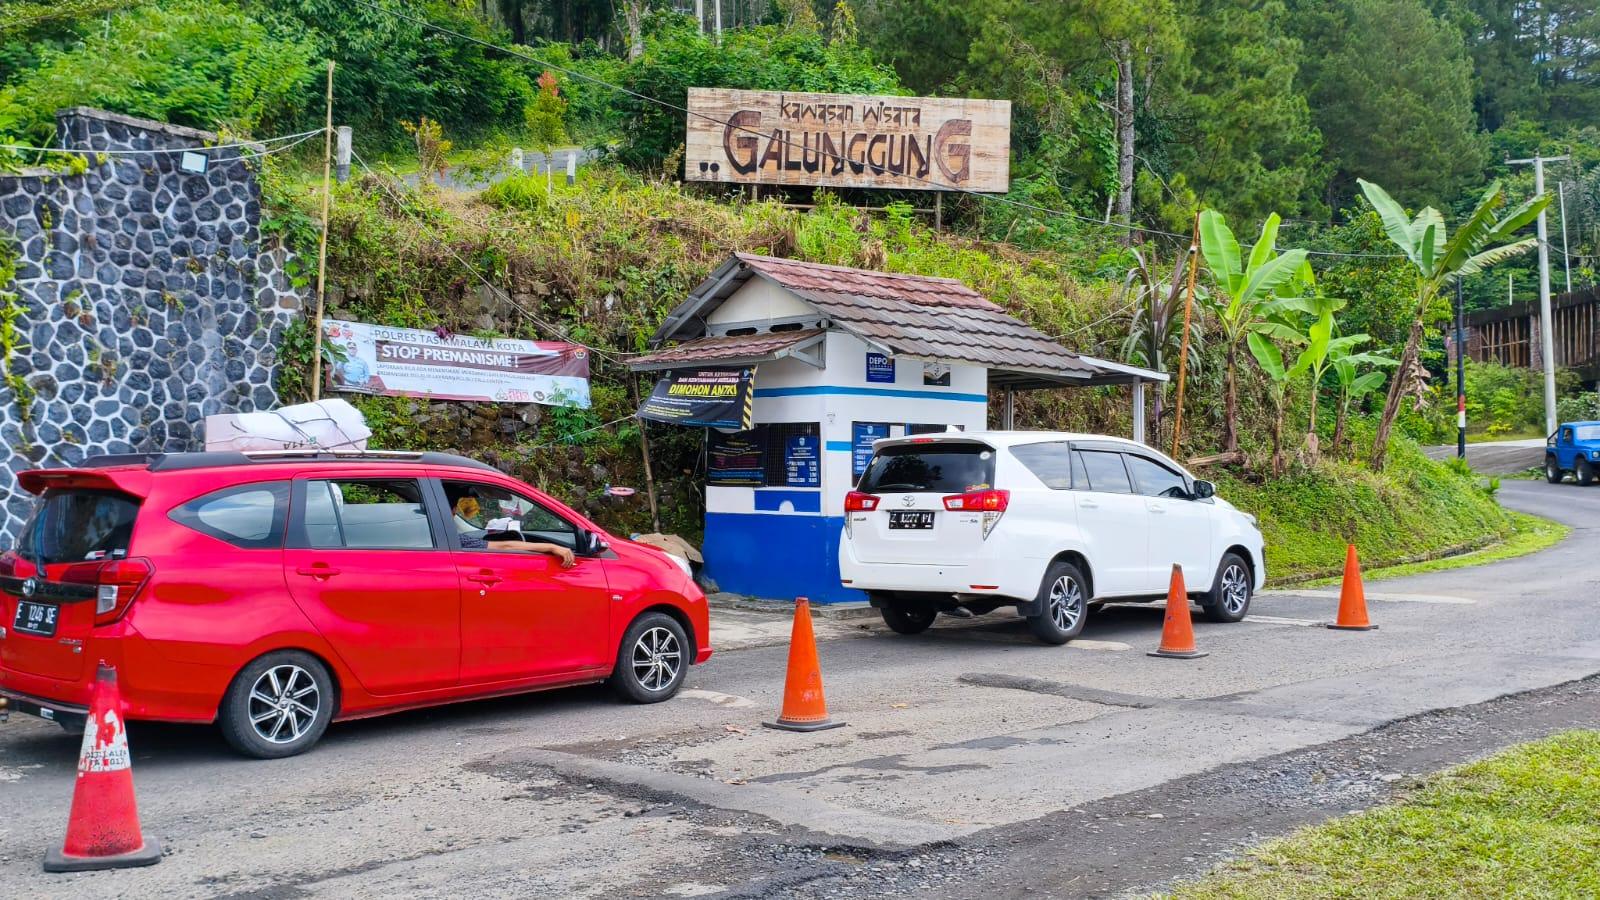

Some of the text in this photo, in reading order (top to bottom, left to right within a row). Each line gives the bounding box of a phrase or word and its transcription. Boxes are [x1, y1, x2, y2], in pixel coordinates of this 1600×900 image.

[723, 109, 972, 184] GALUNGGUNG
[375, 330, 525, 352] POLRES TASIKMALAYA KOTA
[382, 345, 420, 360] STOP
[423, 348, 512, 367] PREMANISME
[869, 356, 888, 365] DEPO
[668, 384, 710, 395] DIMOHON
[890, 513, 897, 523] Z
[16, 603, 57, 624] E 1246 SE
